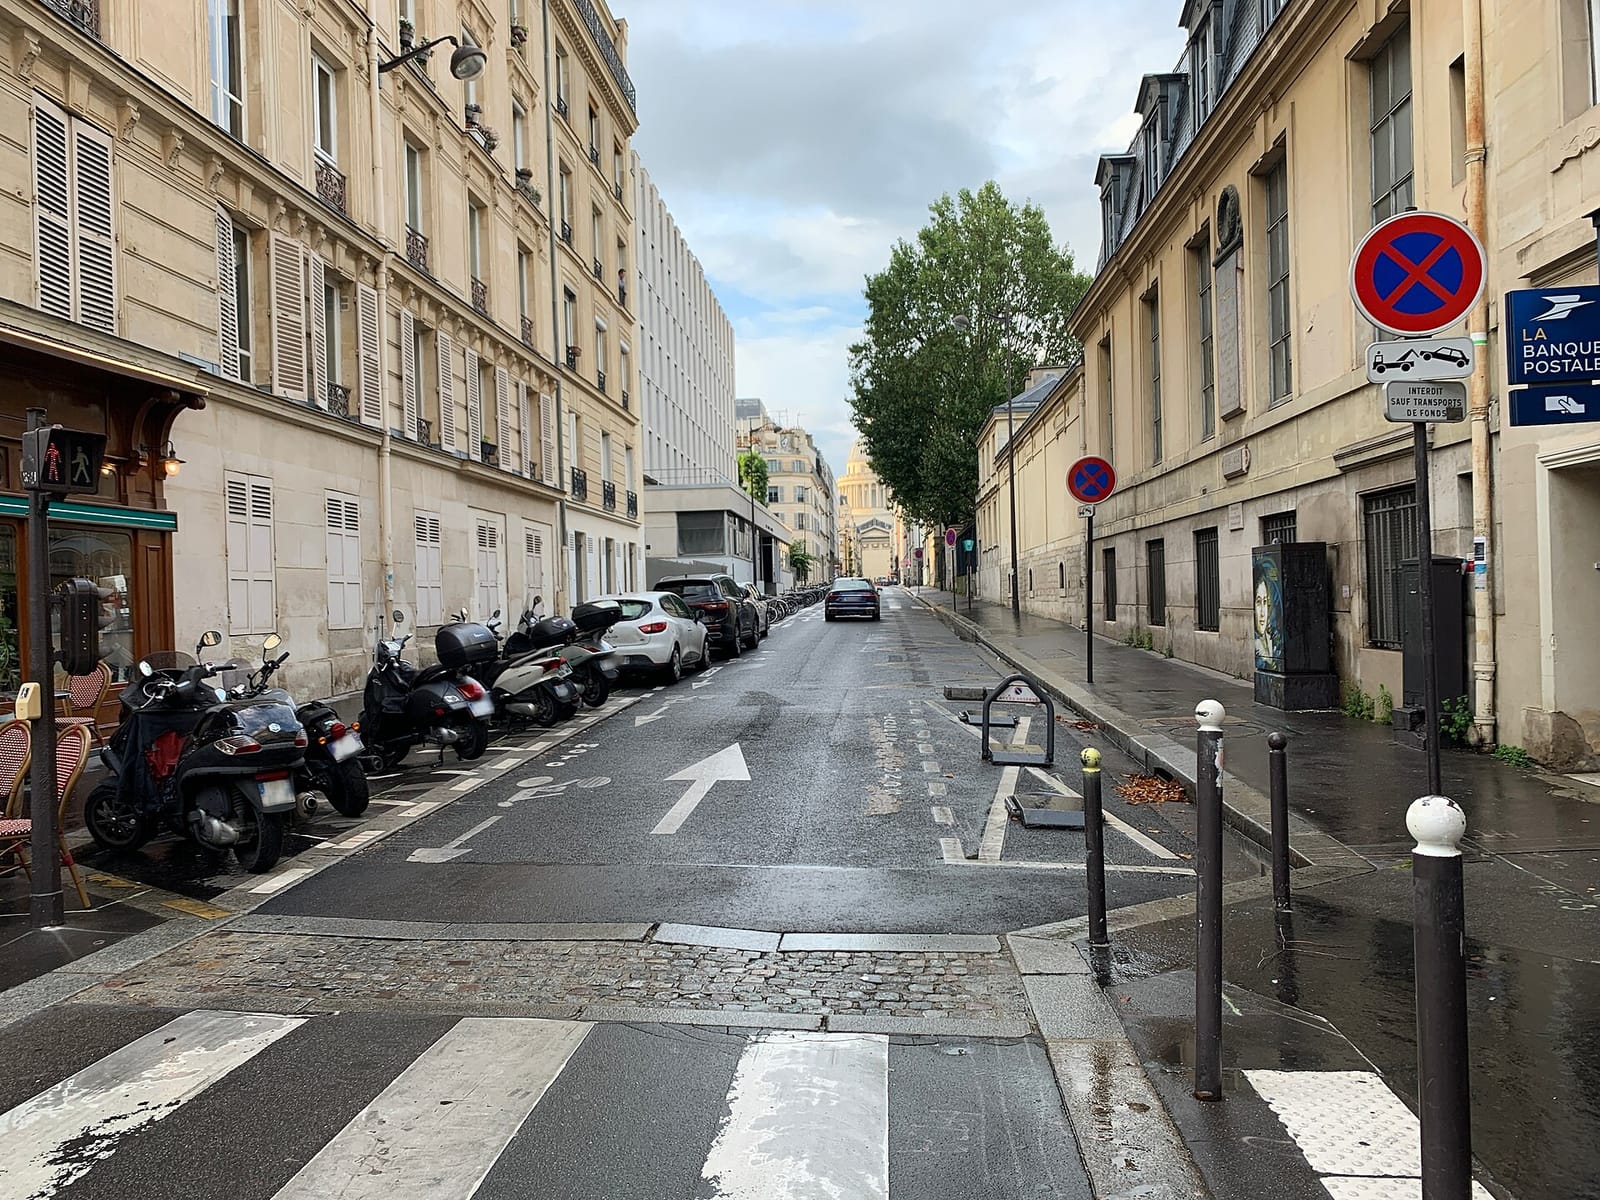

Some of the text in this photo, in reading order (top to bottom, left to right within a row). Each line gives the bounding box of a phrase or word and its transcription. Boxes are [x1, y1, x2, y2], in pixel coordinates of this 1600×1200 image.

[1522, 327, 1547, 341] LA
[1523, 340, 1600, 358] BANQUE
[1523, 357, 1600, 375] POSTALE
[1408, 386, 1443, 395] INTERDIT
[1390, 397, 1462, 407] SAUF TRANSPORTS
[1406, 408, 1447, 418] DE FONDS
